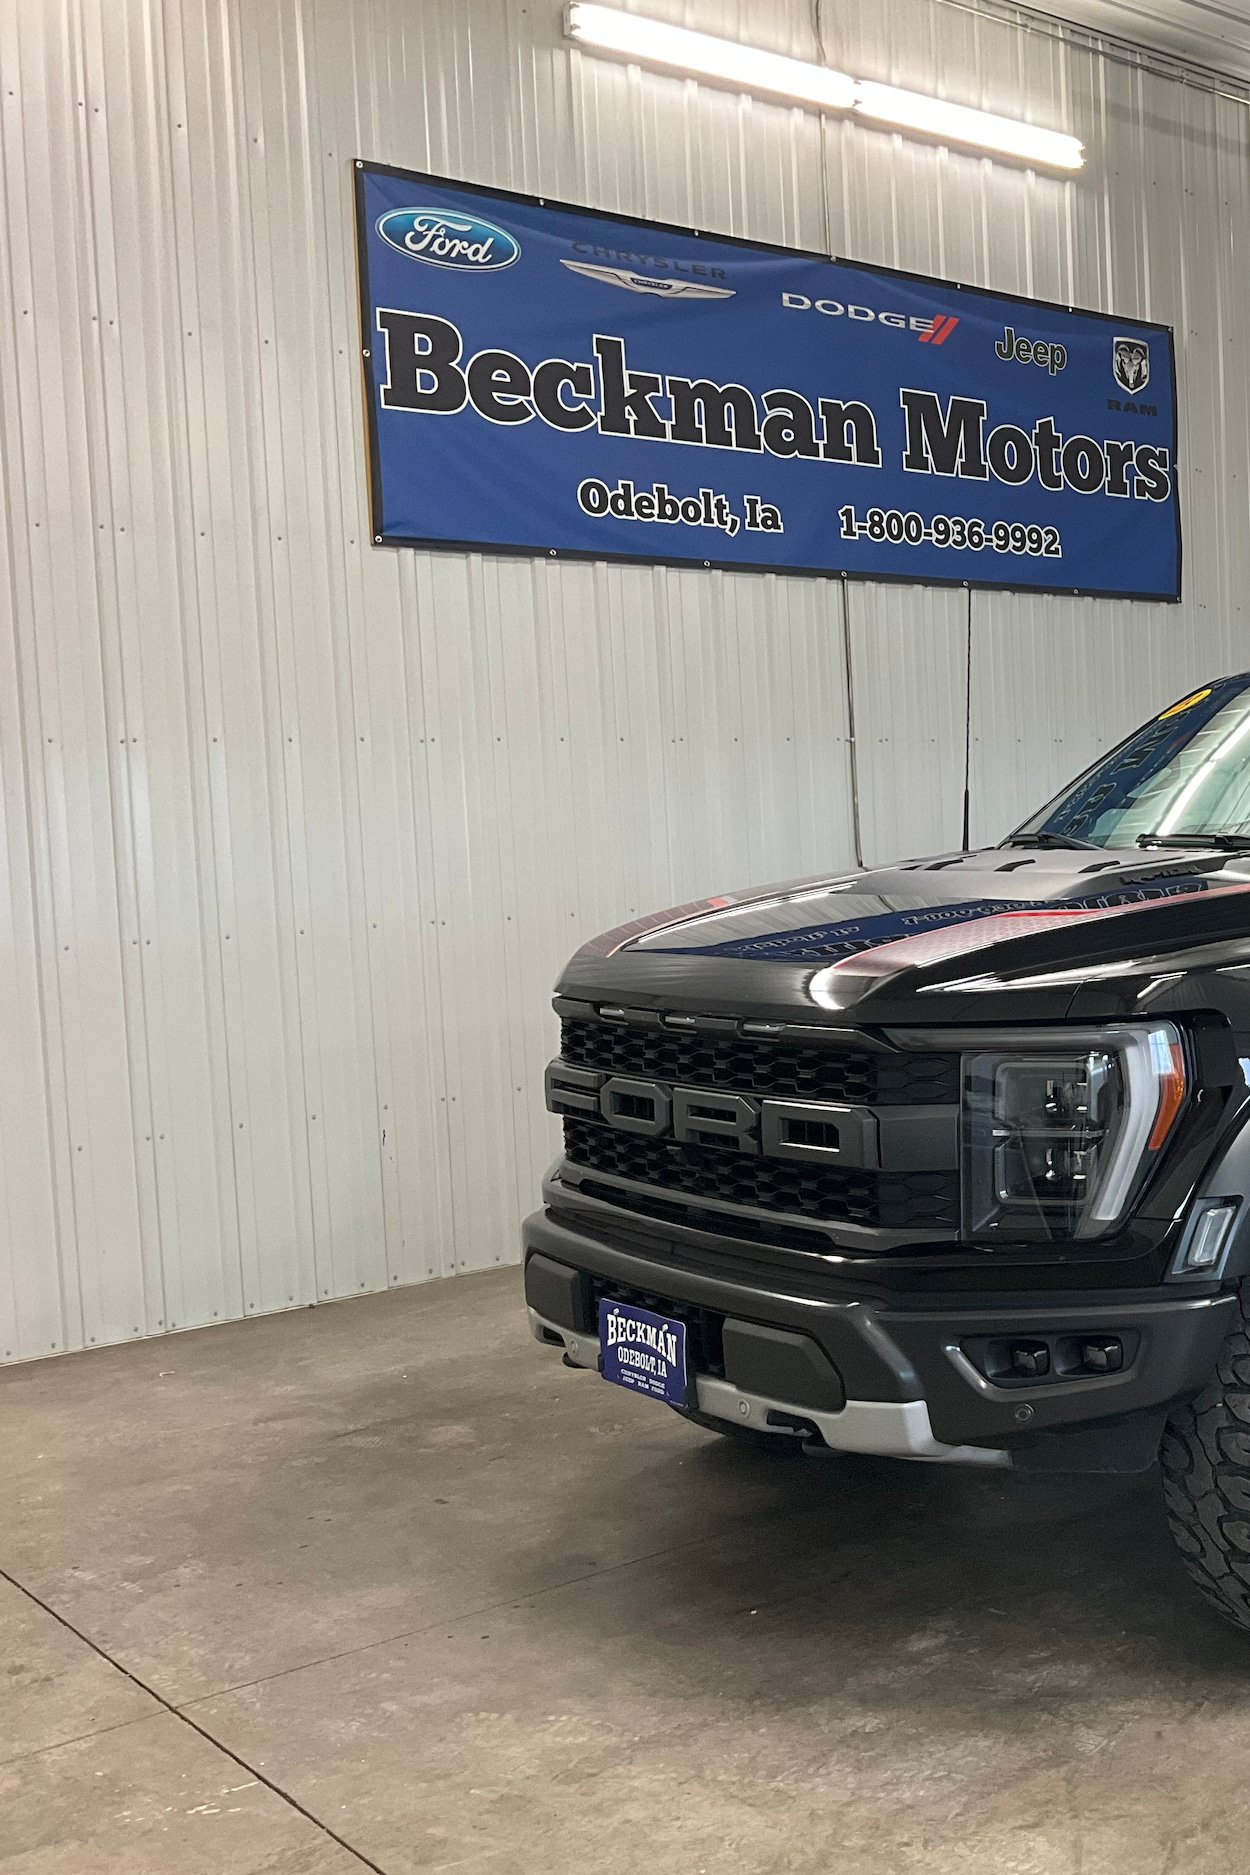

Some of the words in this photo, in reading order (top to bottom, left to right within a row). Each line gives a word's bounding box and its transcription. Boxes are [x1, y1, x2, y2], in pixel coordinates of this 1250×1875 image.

[404, 215, 494, 263] Ford
[571, 240, 726, 280] CHRYSLER
[782, 292, 935, 332] DODGE
[994, 326, 1068, 376] Jeep
[375, 306, 883, 469] Beckman
[899, 387, 1171, 502] Motors
[1107, 398, 1158, 417] RAM
[577, 478, 740, 537] Odebolt,
[744, 495, 784, 534] Ia
[838, 504, 1063, 558] 1-800-936-9992
[545, 1058, 879, 1169] FORD
[606, 1312, 678, 1368] BECKMAN
[617, 1345, 657, 1376] ODEBOLT,
[657, 1359, 668, 1378] IA
